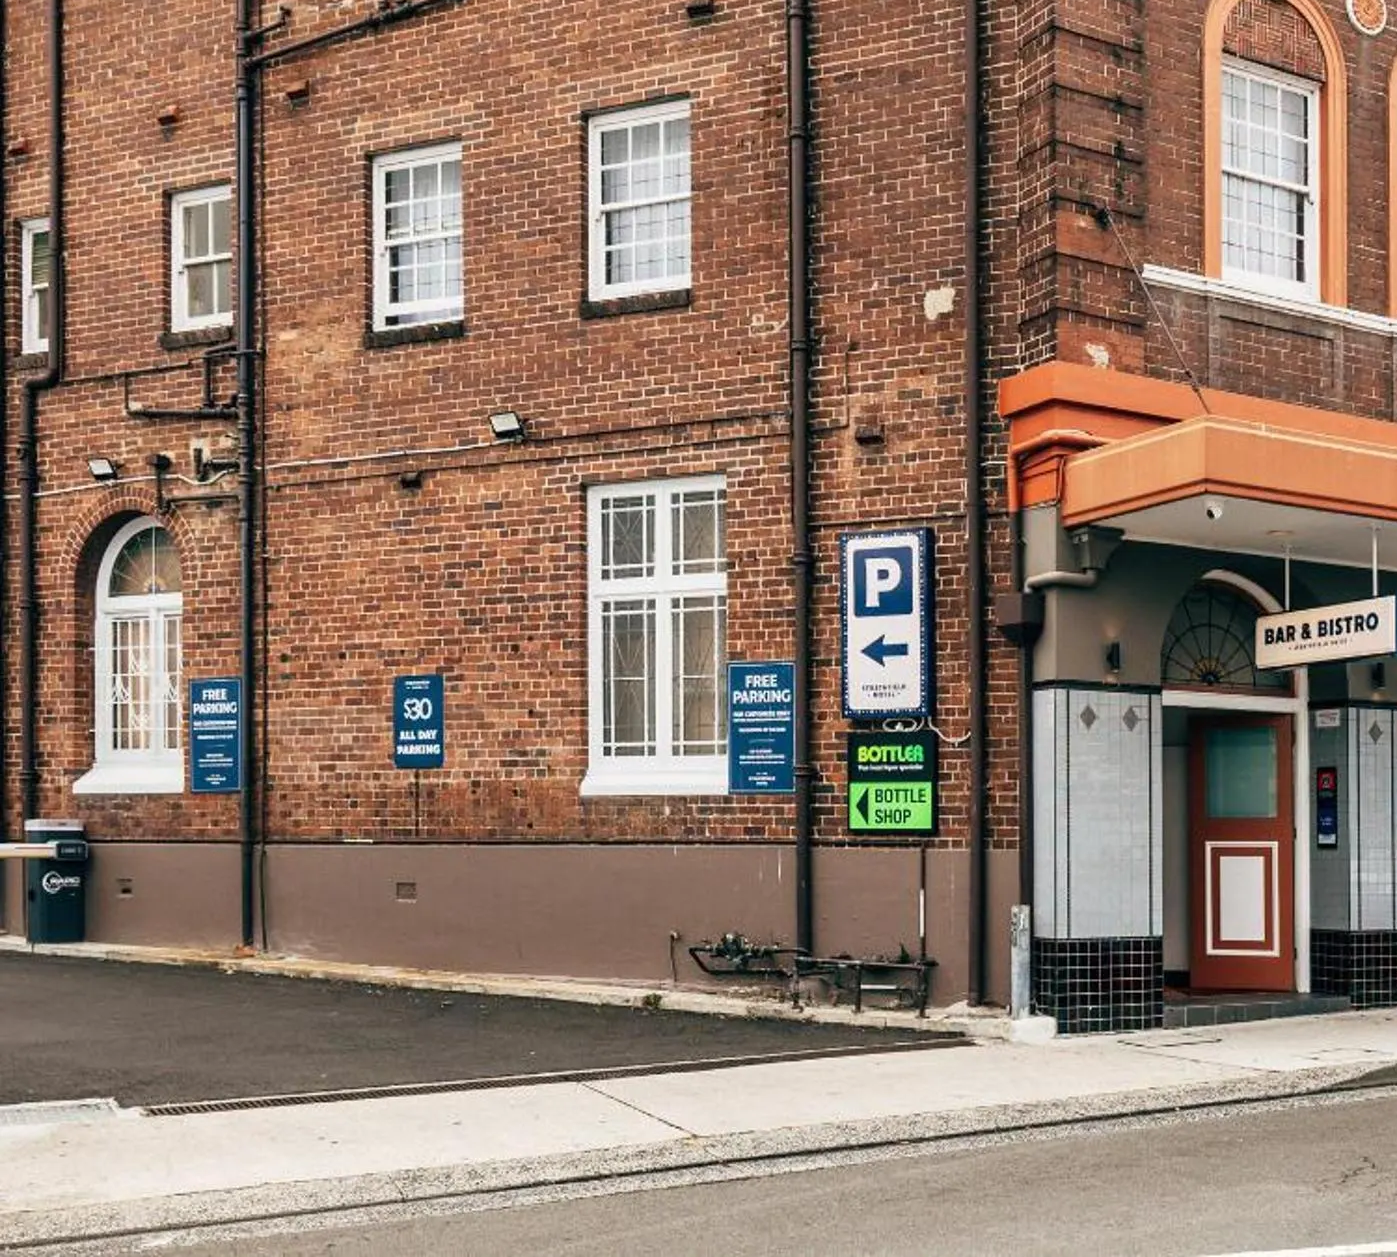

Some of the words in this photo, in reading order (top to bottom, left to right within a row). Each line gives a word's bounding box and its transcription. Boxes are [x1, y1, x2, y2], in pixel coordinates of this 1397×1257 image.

[864, 557, 902, 608] P
[1264, 625, 1296, 645] BAR
[1301, 623, 1312, 640] &
[1317, 611, 1379, 637] BISTRO
[744, 674, 778, 688] FREE
[202, 688, 228, 701] FREE
[732, 689, 792, 705] PARKING
[193, 702, 238, 715] PARKING
[403, 697, 433, 720] $30
[399, 730, 416, 740] ALL
[418, 729, 438, 740] DAY
[396, 743, 441, 755] PARKING
[874, 787, 927, 804] BOTTLE
[874, 808, 912, 825] SHOP
